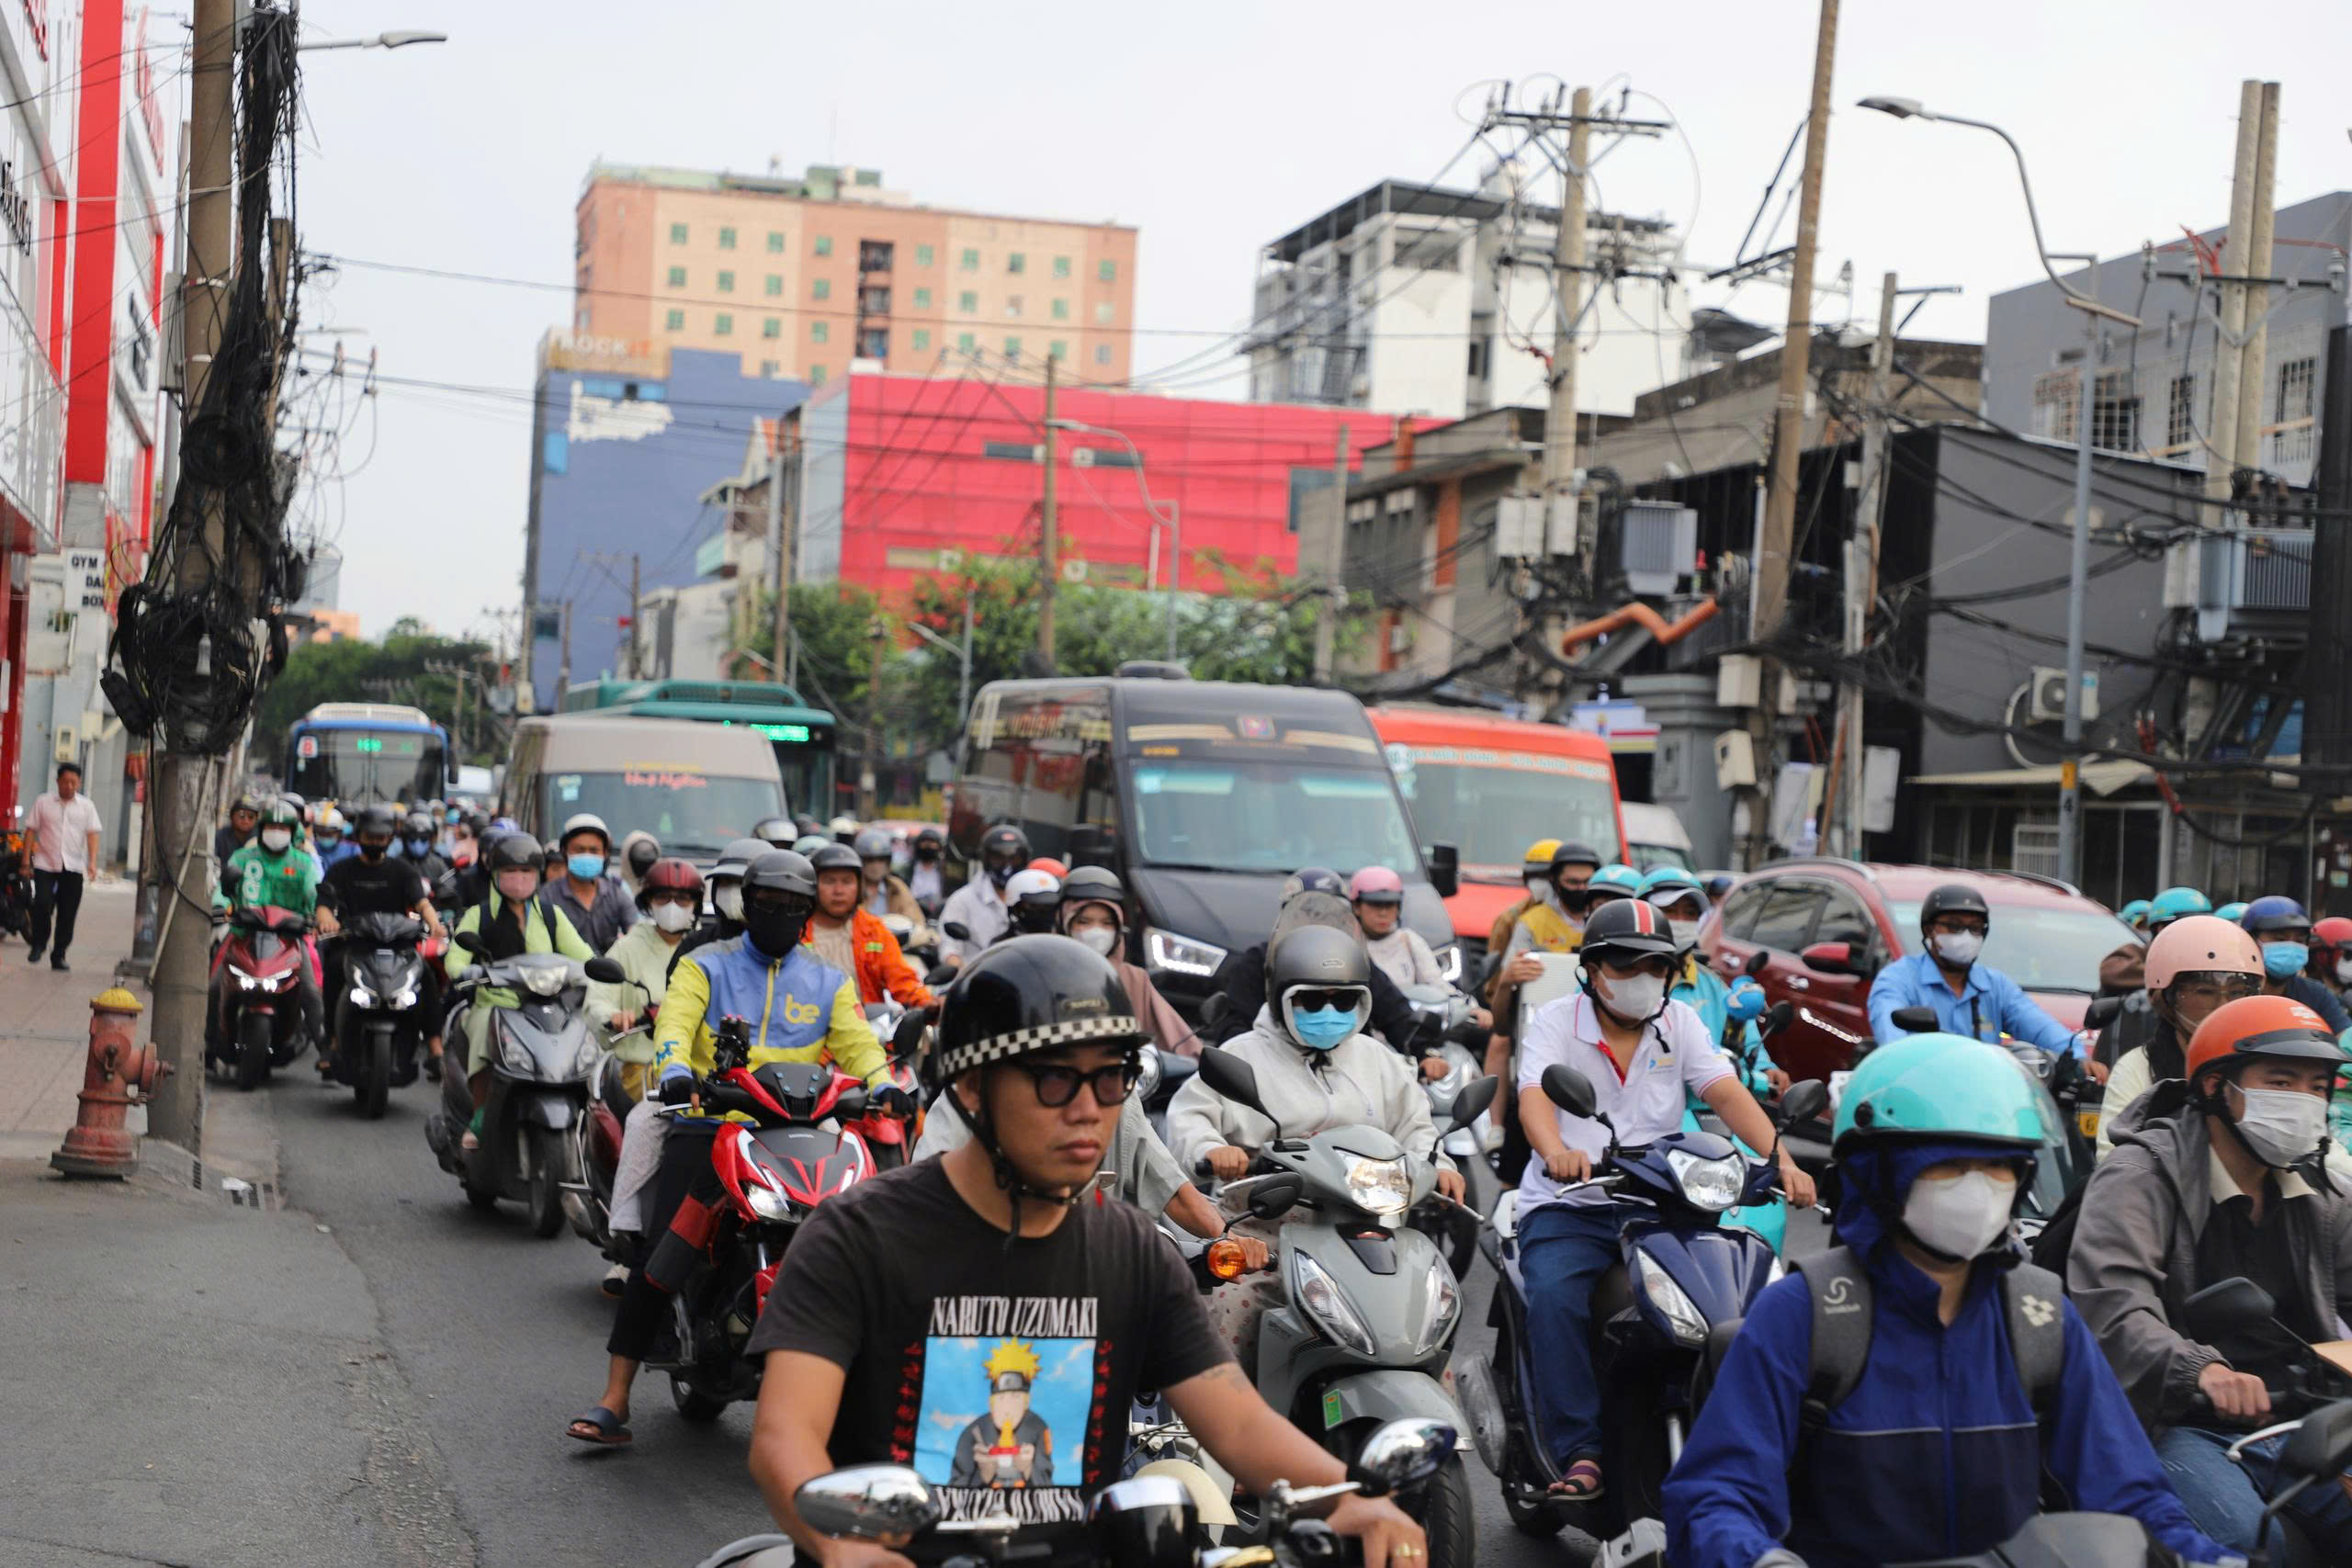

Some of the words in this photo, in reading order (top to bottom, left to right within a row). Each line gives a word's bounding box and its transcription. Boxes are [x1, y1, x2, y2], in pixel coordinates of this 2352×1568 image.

[785, 993, 820, 1024] be
[928, 1296, 1011, 1336] NARUTO
[1012, 1297, 1099, 1337] UZUMAKI
